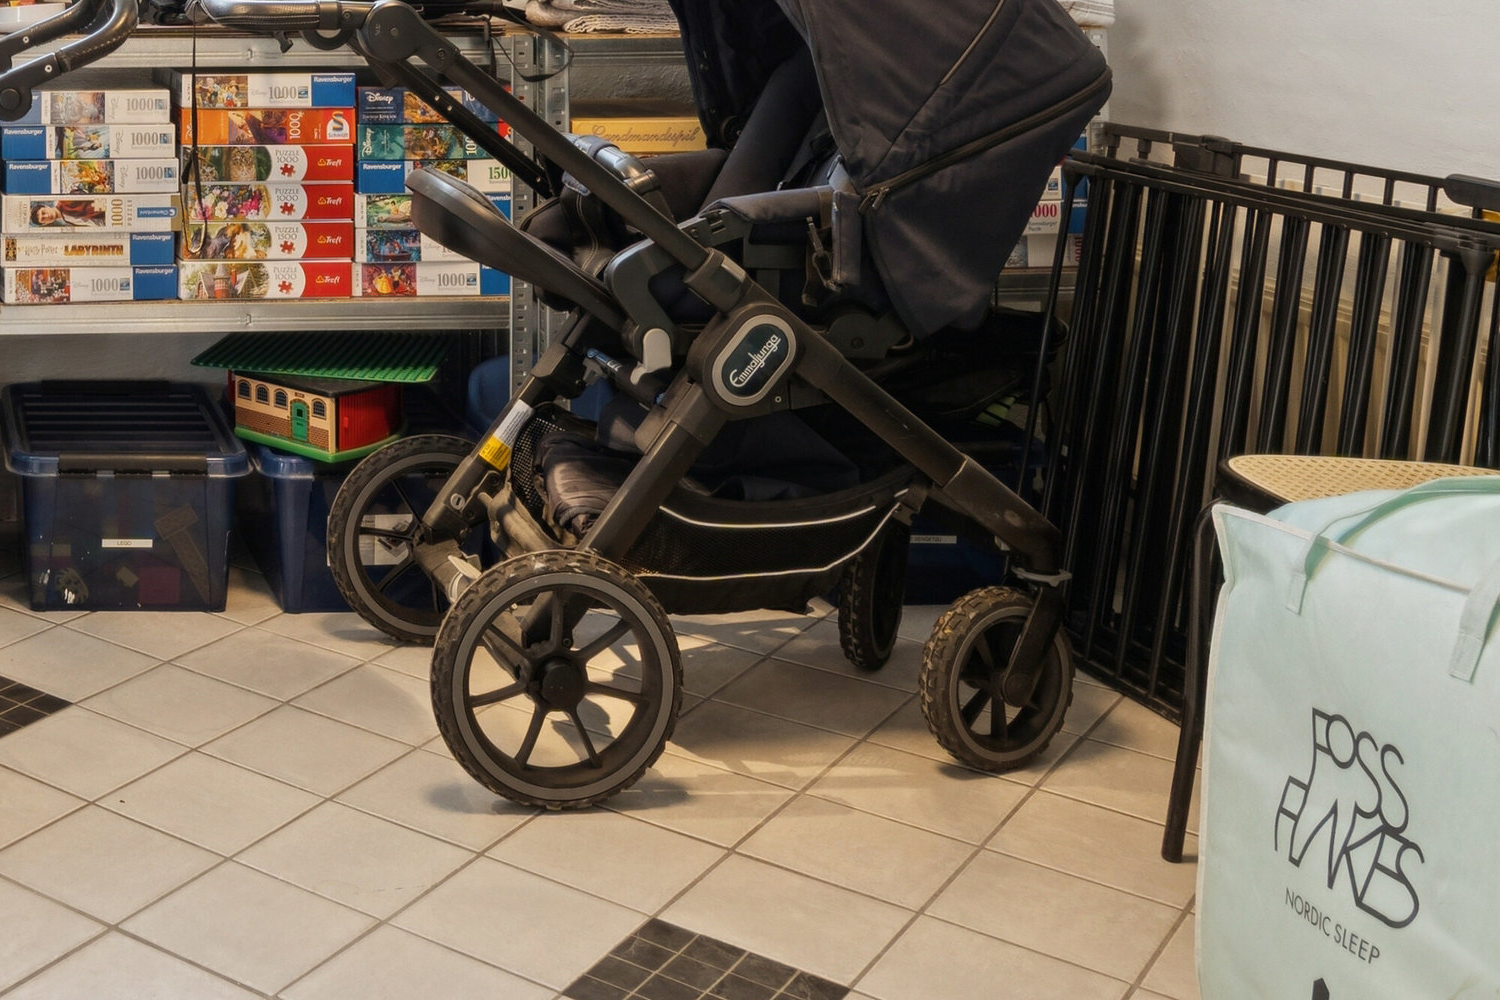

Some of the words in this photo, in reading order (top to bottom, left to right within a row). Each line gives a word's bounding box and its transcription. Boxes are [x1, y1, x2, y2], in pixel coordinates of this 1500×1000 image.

[268, 86, 297, 100] 1000
[313, 75, 353, 84] Ravensburger
[364, 91, 394, 104] Disney
[126, 98, 154, 112] 1000
[3, 128, 43, 136] Ravensburger
[131, 132, 159, 146] 1000
[9, 163, 49, 171] Ravensburger
[325, 158, 342, 166] Trefl
[363, 163, 402, 171] Ravensburger
[136, 166, 164, 180] 1000
[276, 194, 299, 202] 1000
[325, 197, 343, 205] Trefl
[1030, 203, 1057, 218] 000
[132, 234, 172, 242] Ravensburger
[276, 233, 298, 241] 1500
[325, 236, 342, 244] Trefl
[64, 244, 124, 257] LABYRINTH
[91, 278, 119, 292] 1000
[135, 267, 174, 276] Ravensburger
[274, 273, 297, 281] 1000
[323, 275, 341, 284] Trefl
[437, 272, 466, 287] 1000
[729, 334, 781, 388] Emmaljunga
[1311, 706, 1409, 835] FOSS
[1284, 887, 1331, 938] NORDIC
[1333, 923, 1381, 965] SLEEP
